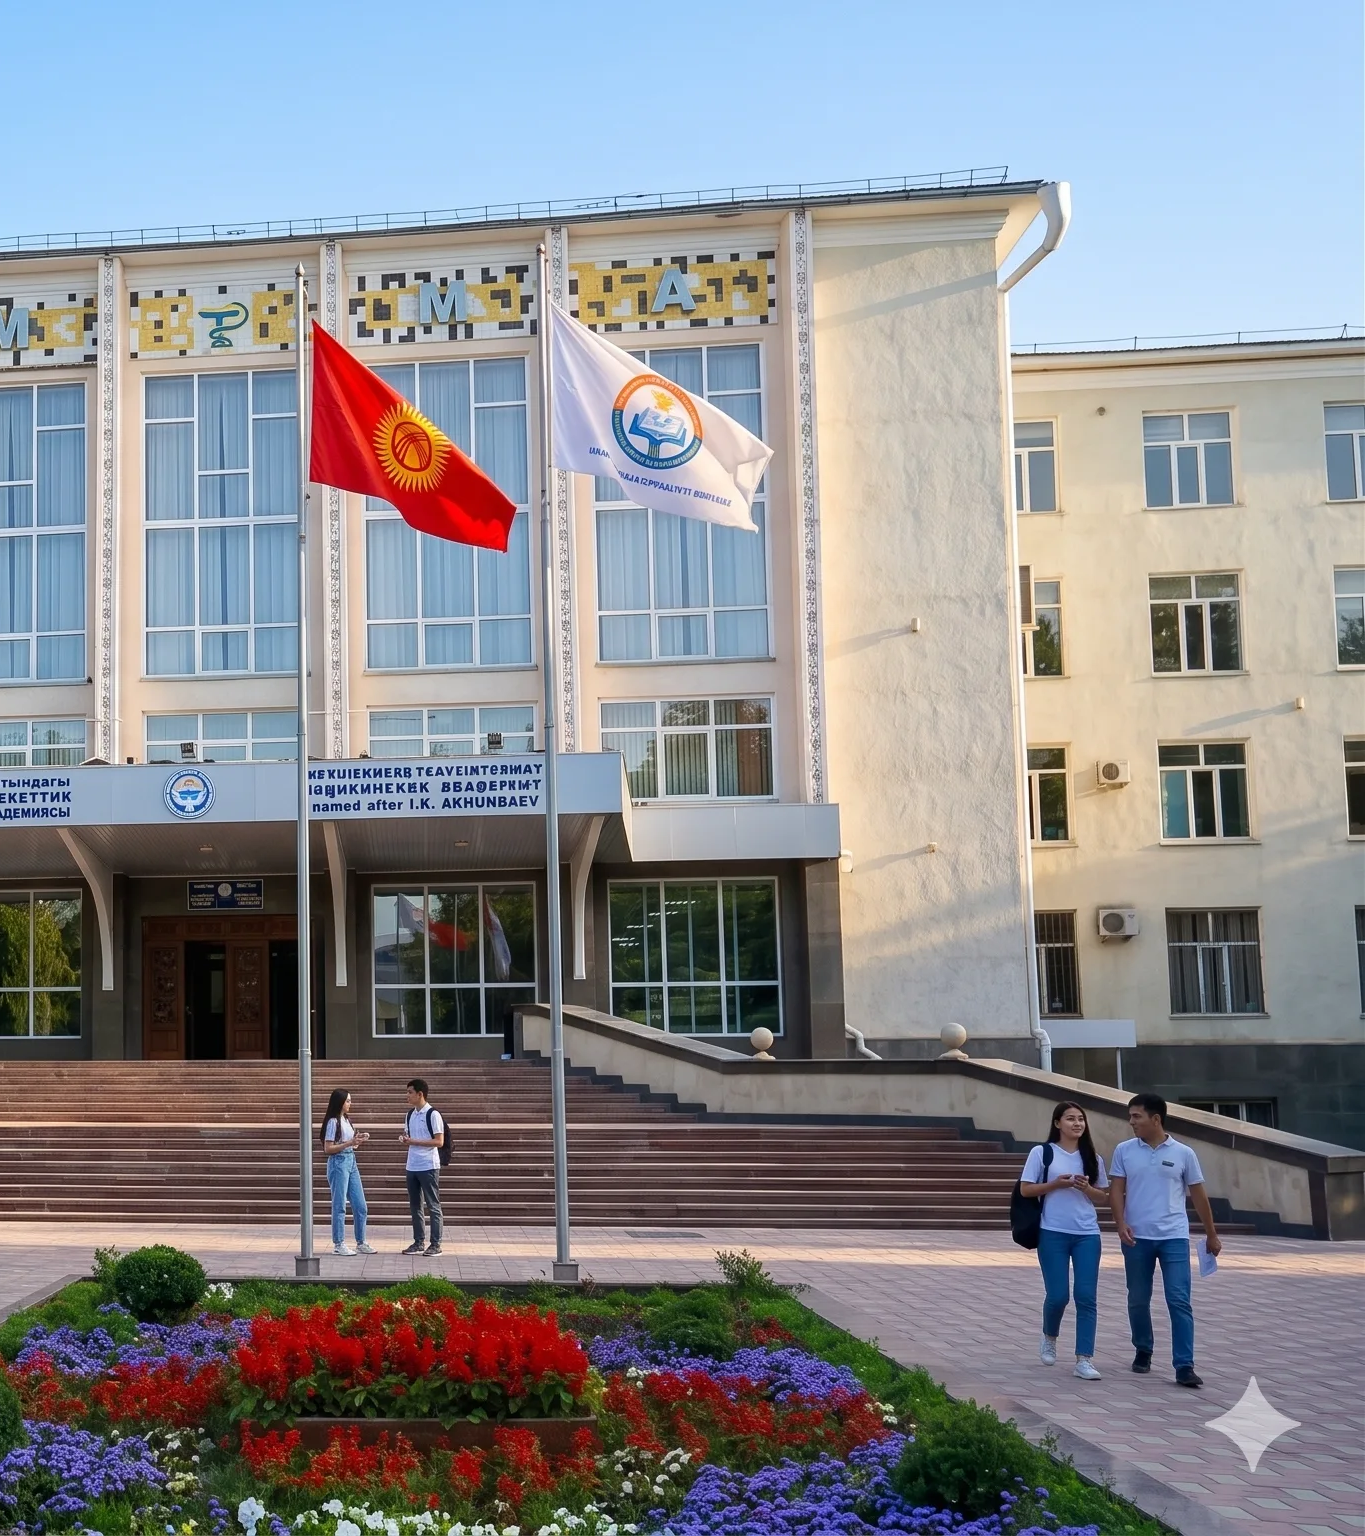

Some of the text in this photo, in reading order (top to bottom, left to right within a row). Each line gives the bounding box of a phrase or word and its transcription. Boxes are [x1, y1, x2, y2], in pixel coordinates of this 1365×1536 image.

[419, 280, 467, 325] М
[651, 269, 696, 313] А
[312, 795, 540, 813] named after I.K. AKHUNBAEV
